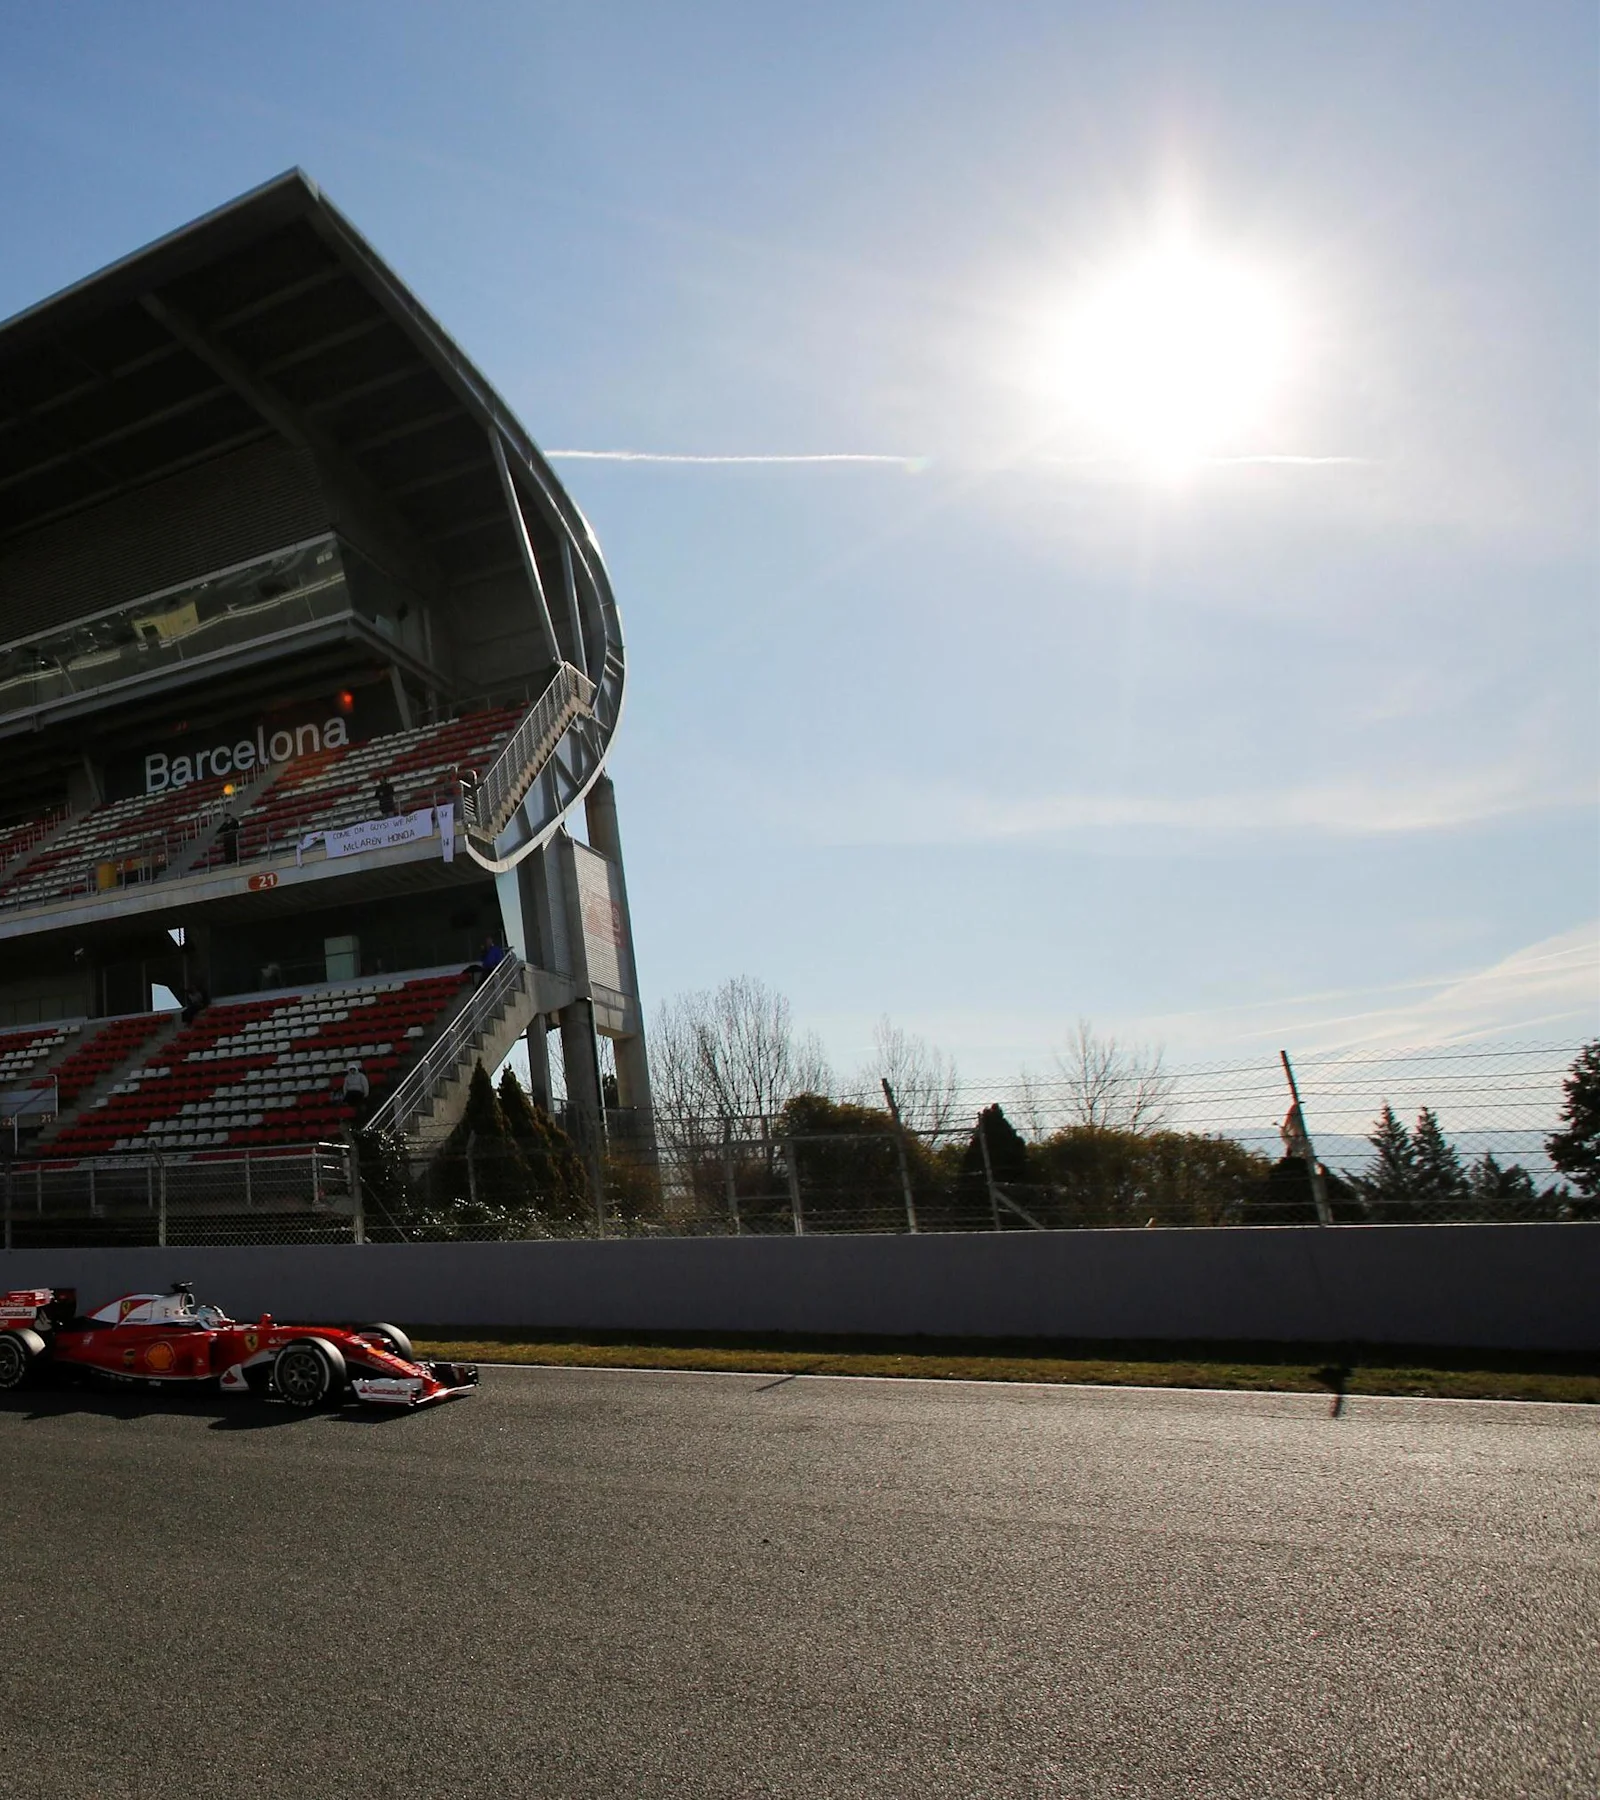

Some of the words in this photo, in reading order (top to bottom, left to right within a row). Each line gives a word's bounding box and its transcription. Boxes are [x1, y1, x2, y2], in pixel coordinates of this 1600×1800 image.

[145, 716, 350, 793] Barcelona
[332, 829, 352, 840] COME
[405, 813, 418, 825] ARE
[387, 829, 416, 843] HONDA
[258, 874, 274, 888] 21
[0, 1308, 32, 1317] Santander
[368, 1385, 408, 1396] Santander
